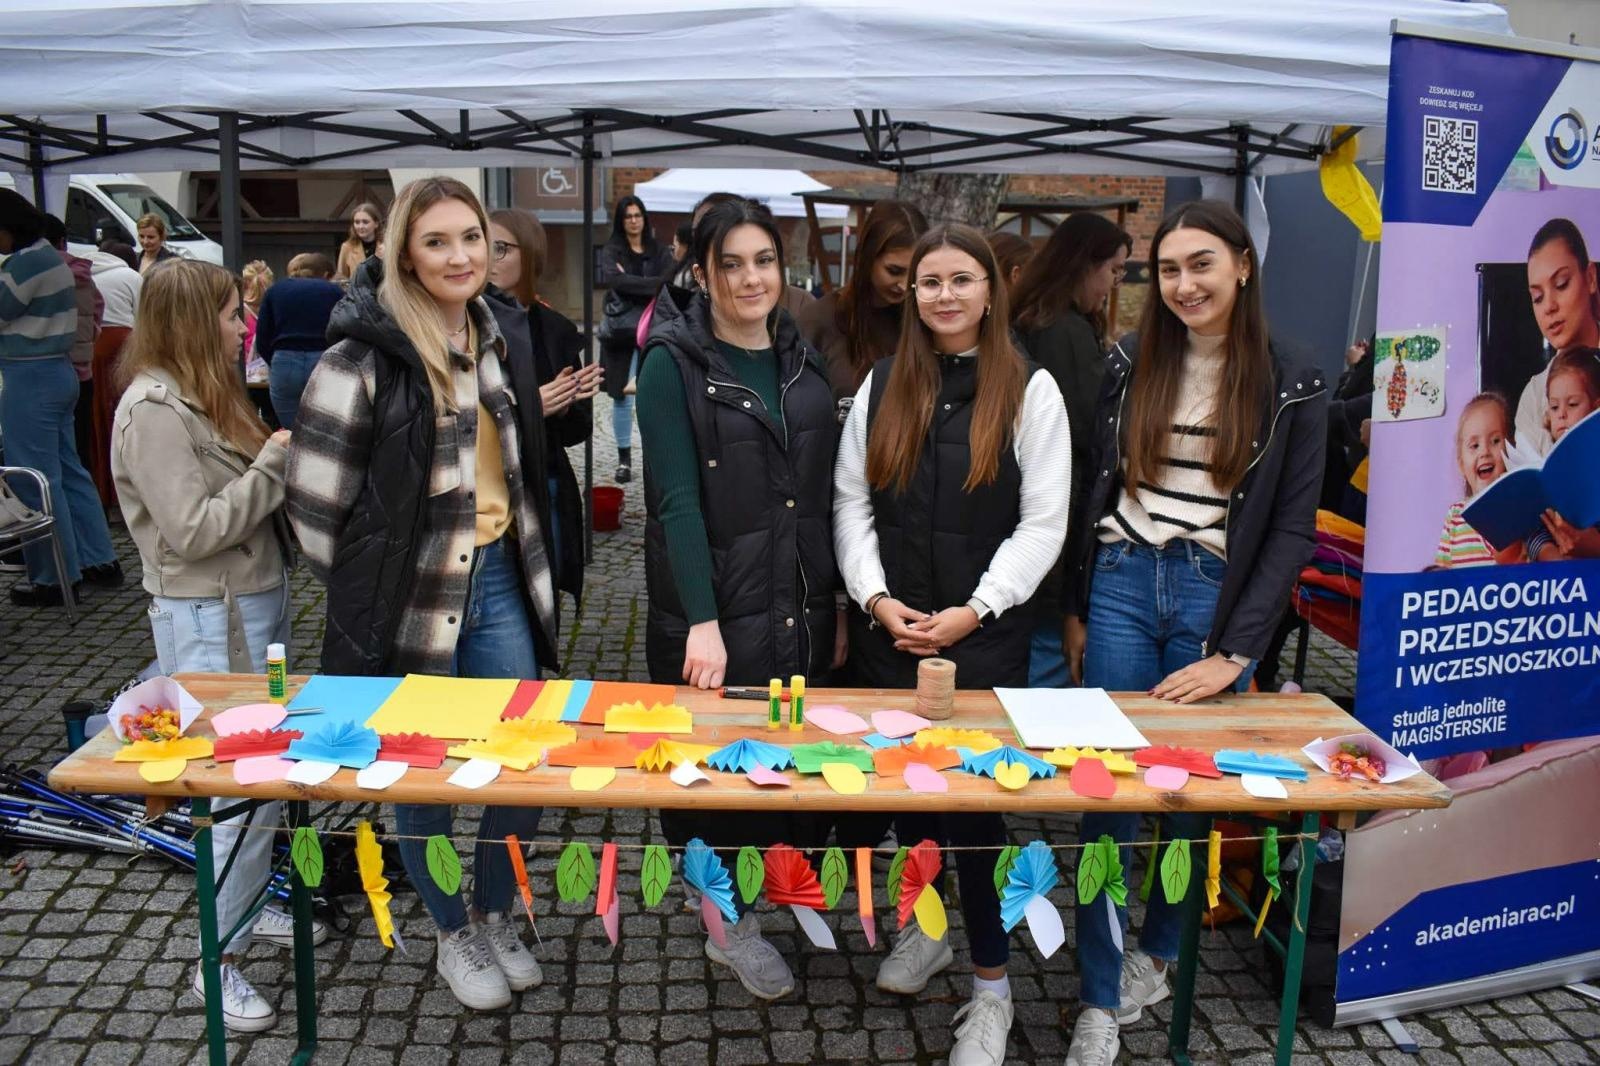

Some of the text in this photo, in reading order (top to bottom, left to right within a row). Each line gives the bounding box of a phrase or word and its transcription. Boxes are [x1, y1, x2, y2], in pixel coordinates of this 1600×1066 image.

[1419, 97, 1447, 108] DOWIEDZ
[1429, 86, 1475, 98] ZESKANUJ KOD
[1401, 577, 1588, 620] PEDAGOGIKA
[1395, 666, 1403, 688] I
[1392, 696, 1507, 728] studia jednolite
[1391, 714, 1507, 748] MAGISTERSKIE
[1415, 895, 1576, 946] akademiarac.pl
